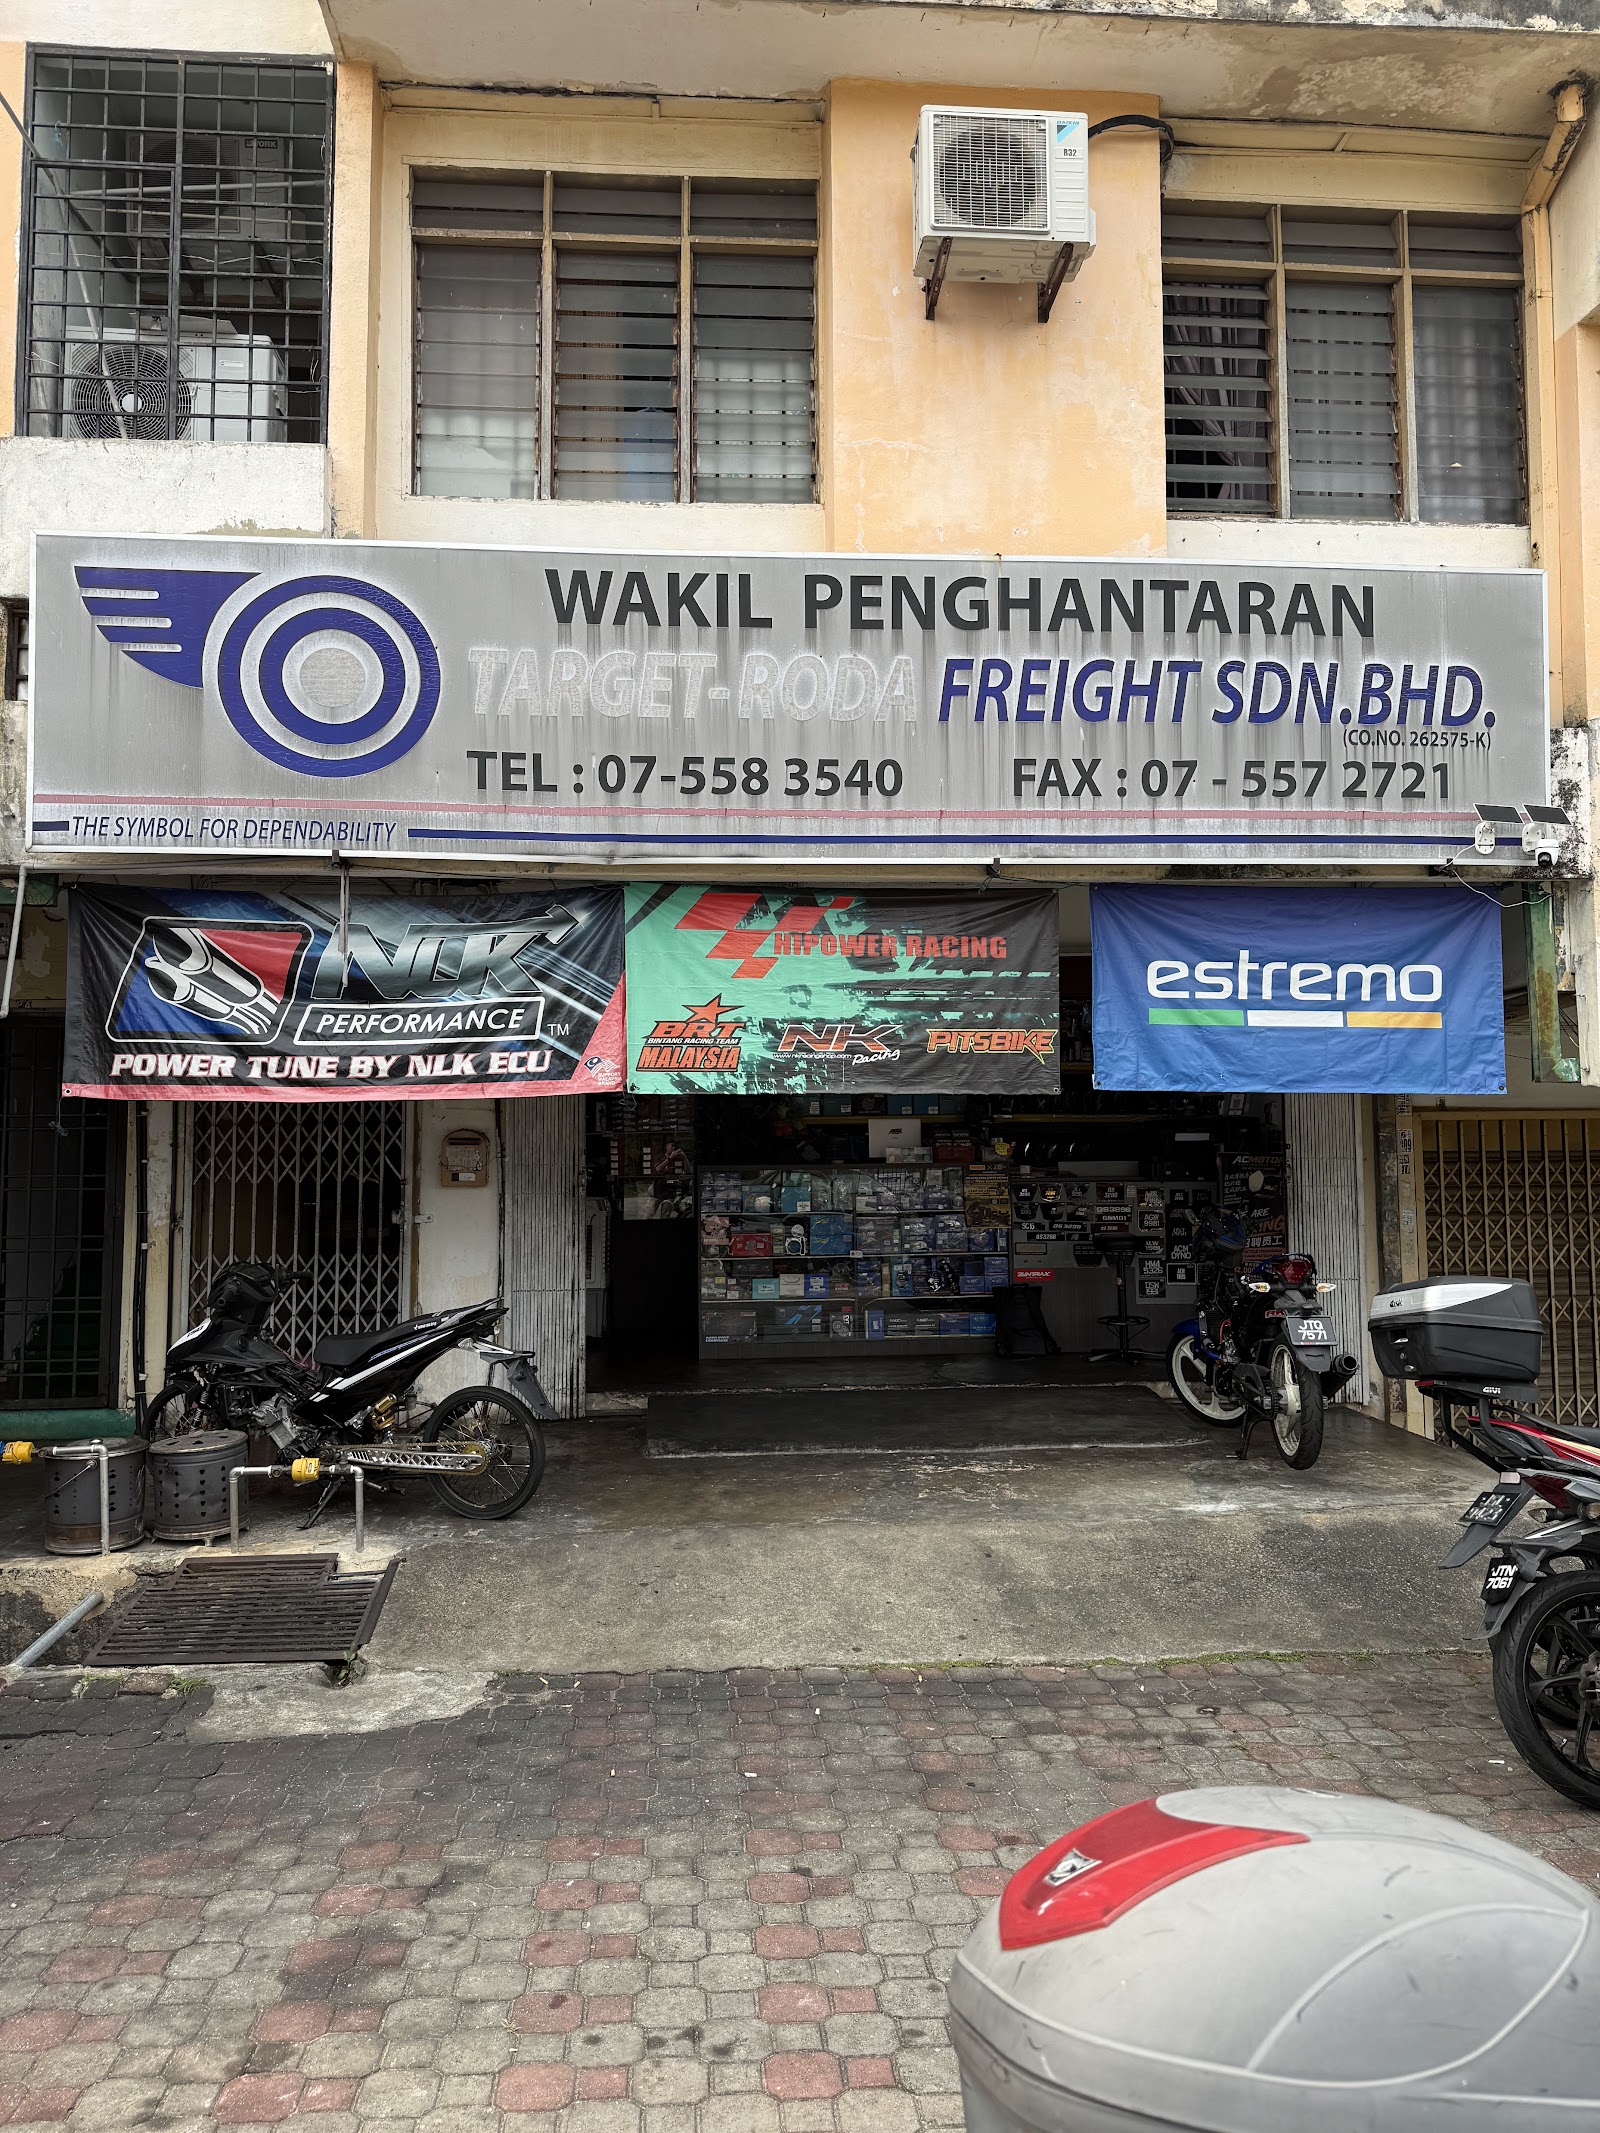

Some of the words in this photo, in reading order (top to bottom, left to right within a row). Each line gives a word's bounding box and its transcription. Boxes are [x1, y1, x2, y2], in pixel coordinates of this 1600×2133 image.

[544, 568, 773, 629] WAKIL
[803, 573, 1375, 638] PENGHANTARAN
[468, 647, 917, 722] TARGET-RODA
[938, 657, 1203, 724] FREIGHT
[1409, 730, 1492, 751] 262575-K)
[467, 750, 558, 792] TEL
[598, 754, 769, 795] 07-558
[784, 757, 904, 797] 3540
[1013, 758, 1103, 798] FAX
[1142, 760, 1198, 799] 07
[1242, 760, 1327, 799] 557
[1343, 762, 1450, 800] 2721
[72, 816, 109, 837] THE
[114, 817, 195, 839] SYMBOL
[200, 818, 239, 840] FOR
[243, 819, 398, 843] DEPENDABILITY
[773, 932, 898, 958] HIPOWER
[905, 935, 1007, 960] RACING
[1147, 949, 1443, 1003] estremo
[316, 1008, 525, 1035] PERFORMANCE
[547, 1023, 569, 1036] TM
[644, 1021, 746, 1038] BRT
[777, 1024, 903, 1052] NK
[926, 1029, 1058, 1064] PITSBIKE
[108, 1052, 237, 1079] POWER
[246, 1054, 339, 1079] TUNE
[347, 1053, 402, 1079] BY
[405, 1052, 482, 1077] NLK
[486, 1049, 555, 1075] ECU
[637, 1046, 741, 1069] MALAYSIA
[852, 1049, 900, 1065] Racing
[1298, 1330, 1328, 1340] 7571
[1299, 1320, 1324, 1330] JTQ
[1486, 1577, 1514, 1590] 7061
[1491, 1565, 1516, 1577] JTN
